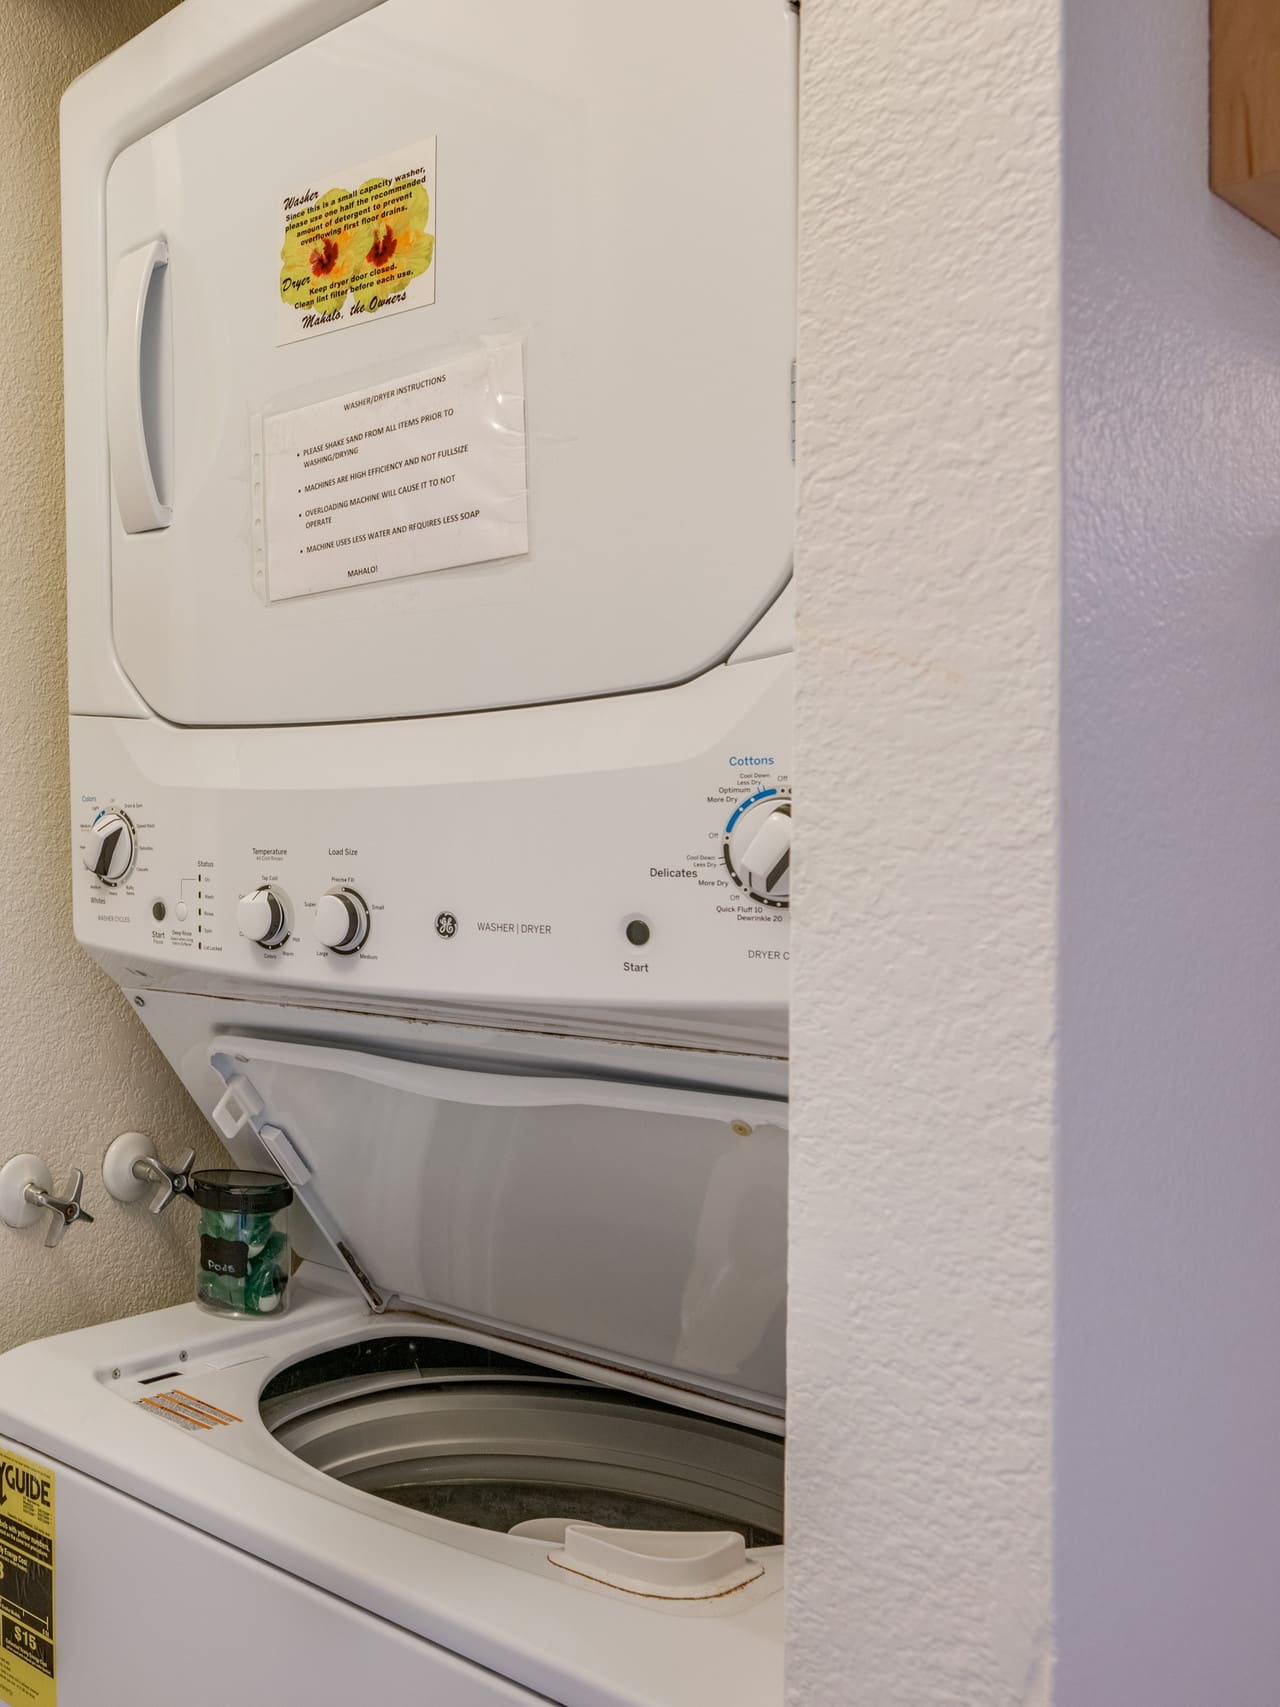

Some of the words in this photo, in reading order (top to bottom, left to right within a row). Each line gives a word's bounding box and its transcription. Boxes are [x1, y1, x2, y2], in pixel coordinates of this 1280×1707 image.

[283, 188, 318, 211] Washer
[285, 219, 308, 234] please
[310, 214, 323, 223] use
[325, 209, 338, 217] one
[340, 201, 354, 212] half
[356, 198, 369, 206] the
[371, 176, 426, 201] recommended
[286, 210, 305, 222] Since
[307, 204, 320, 214] this
[338, 190, 357, 203] small
[360, 178, 393, 195] capacity
[395, 167, 426, 182] washer,
[297, 223, 323, 238] amount
[325, 220, 332, 228] of
[334, 206, 371, 224] detergent
[373, 203, 381, 211] to
[383, 192, 412, 209] prevent
[300, 227, 342, 246] overflowing
[343, 221, 359, 231] first
[361, 214, 379, 225] floor
[381, 205, 408, 218] drains.
[283, 276, 310, 292] Dryer
[295, 299, 314, 309] Clean
[316, 294, 328, 303] lint
[330, 289, 348, 299] filter
[350, 281, 374, 293] before
[376, 274, 395, 285] each
[397, 270, 414, 278] use.
[309, 285, 328, 295] Keep
[330, 279, 348, 290] dryer
[351, 273, 368, 282] door
[370, 263, 397, 276] closed.
[302, 308, 344, 329] Mahalo,
[350, 300, 365, 316] the
[369, 291, 407, 311] Owners
[344, 390, 395, 411] WASHER/DRYER
[396, 374, 447, 395] INSTRUCTIONS
[303, 444, 326, 456] PLEASE
[325, 438, 345, 450] SHAKE
[346, 433, 363, 444] SAND
[364, 427, 384, 438] FROM
[385, 424, 397, 433] ALL
[398, 417, 419, 429] ITEMS
[420, 411, 442, 424] PRIOR
[444, 408, 454, 417] TO
[303, 447, 359, 468] WASHING/DRYING
[304, 479, 336, 493] MACHINES
[337, 474, 349, 484] ARE
[350, 470, 366, 481] HIGH
[367, 460, 403, 476] EFFICIENCY
[404, 456, 419, 467] AND
[421, 452, 437, 463] NOT
[437, 444, 468, 459] FULLSIZE
[305, 500, 348, 517] OVERLOADING
[349, 493, 379, 506] MACHINE
[381, 489, 397, 499] WILL
[398, 483, 419, 495] CAUSE
[420, 481, 427, 489] IT
[429, 479, 438, 487] TO
[440, 474, 456, 485] NOT
[305, 516, 332, 529] OPERATE
[306, 541, 334, 553] MACHINE
[336, 537, 351, 547] USES
[352, 534, 366, 544] LESS
[367, 529, 391, 540] WATER
[392, 525, 407, 535] AND
[408, 518, 441, 531] REQUIRES
[442, 514, 459, 524] LESS
[460, 509, 480, 520] SOAP
[347, 565, 378, 577] MAHALO!
[729, 756, 775, 766] Cottons
[252, 848, 287, 856] Temperature
[328, 848, 344, 856] Load
[344, 848, 358, 856] Size
[649, 868, 698, 878] Delicates
[716, 880, 728, 888] Dry
[152, 930, 165, 939] Start
[477, 922, 515, 933] WASHER
[521, 924, 552, 934] DRYER
[748, 950, 780, 960] DRYER
[623, 962, 649, 973] Start
[14, 1625, 37, 1650] $15
